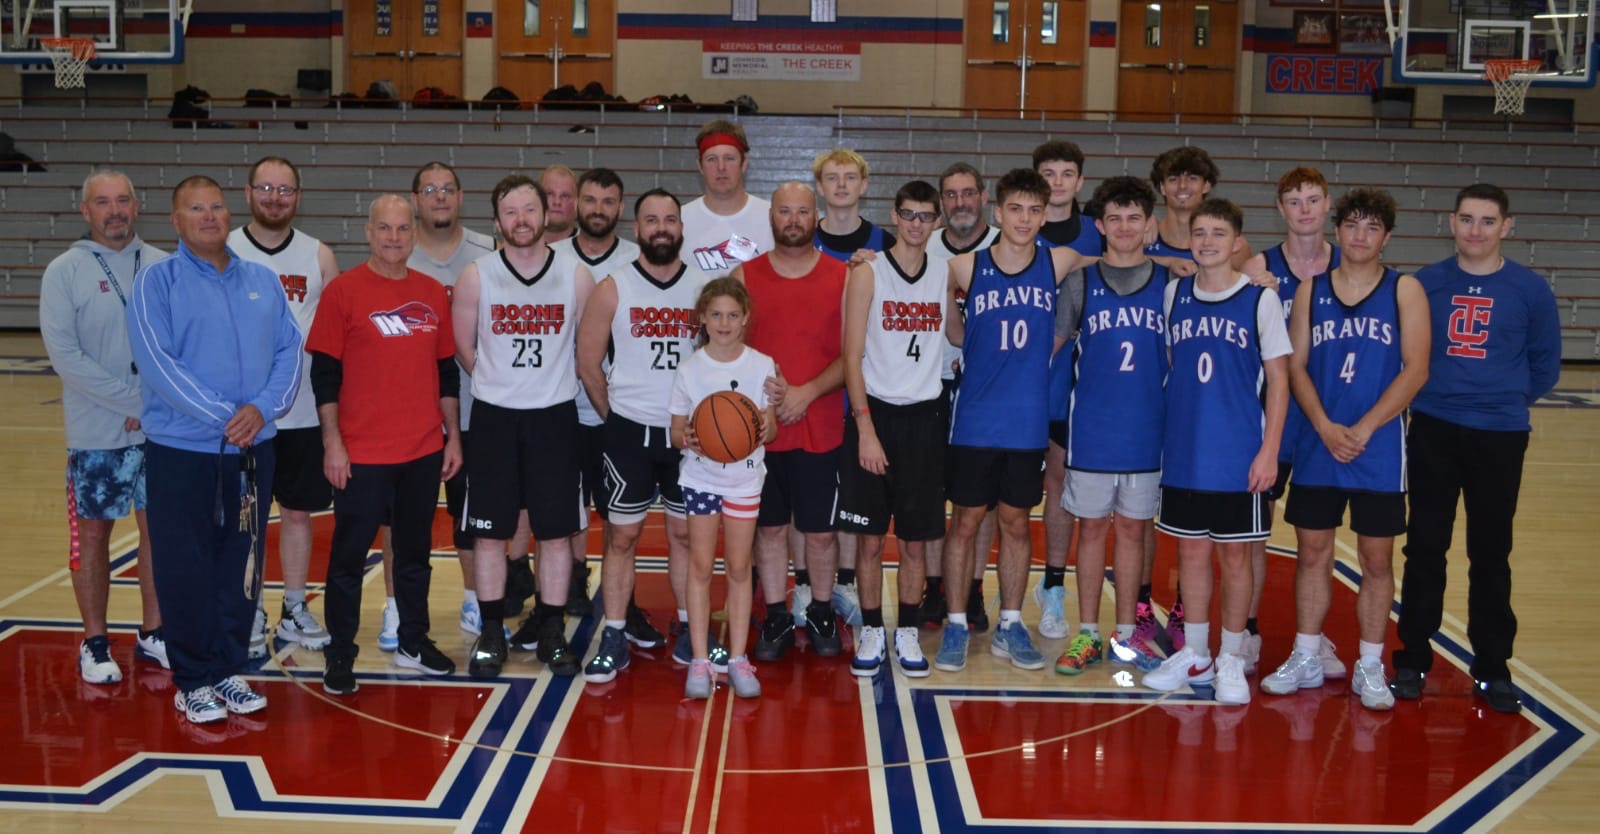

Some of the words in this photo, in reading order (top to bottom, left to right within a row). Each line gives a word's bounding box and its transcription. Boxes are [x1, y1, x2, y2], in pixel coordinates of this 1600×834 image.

[720, 42, 755, 50] KEEPING
[758, 43, 773, 51] THE
[775, 43, 802, 51] CREEK
[805, 44, 843, 52] HEALTHY!
[782, 58, 806, 69] THE
[810, 58, 853, 70] CREEK
[1269, 56, 1381, 93] CREEK
[491, 304, 564, 321] BOONE
[882, 301, 942, 319] BOONE
[975, 286, 1052, 316] BRAVES
[491, 320, 563, 335] COUNTY
[631, 324, 700, 339] COUNTY
[882, 318, 942, 332] COUNTY
[1000, 319, 1028, 350] 10
[1088, 307, 1163, 335] BRAVES
[1172, 316, 1248, 348] BRAVES
[1312, 317, 1392, 347] BRAVES
[512, 338, 541, 368] 23
[651, 341, 680, 370] 25
[906, 334, 920, 362] 4
[1120, 341, 1135, 371] 2
[1197, 352, 1212, 383] 0
[1340, 352, 1356, 383] 4
